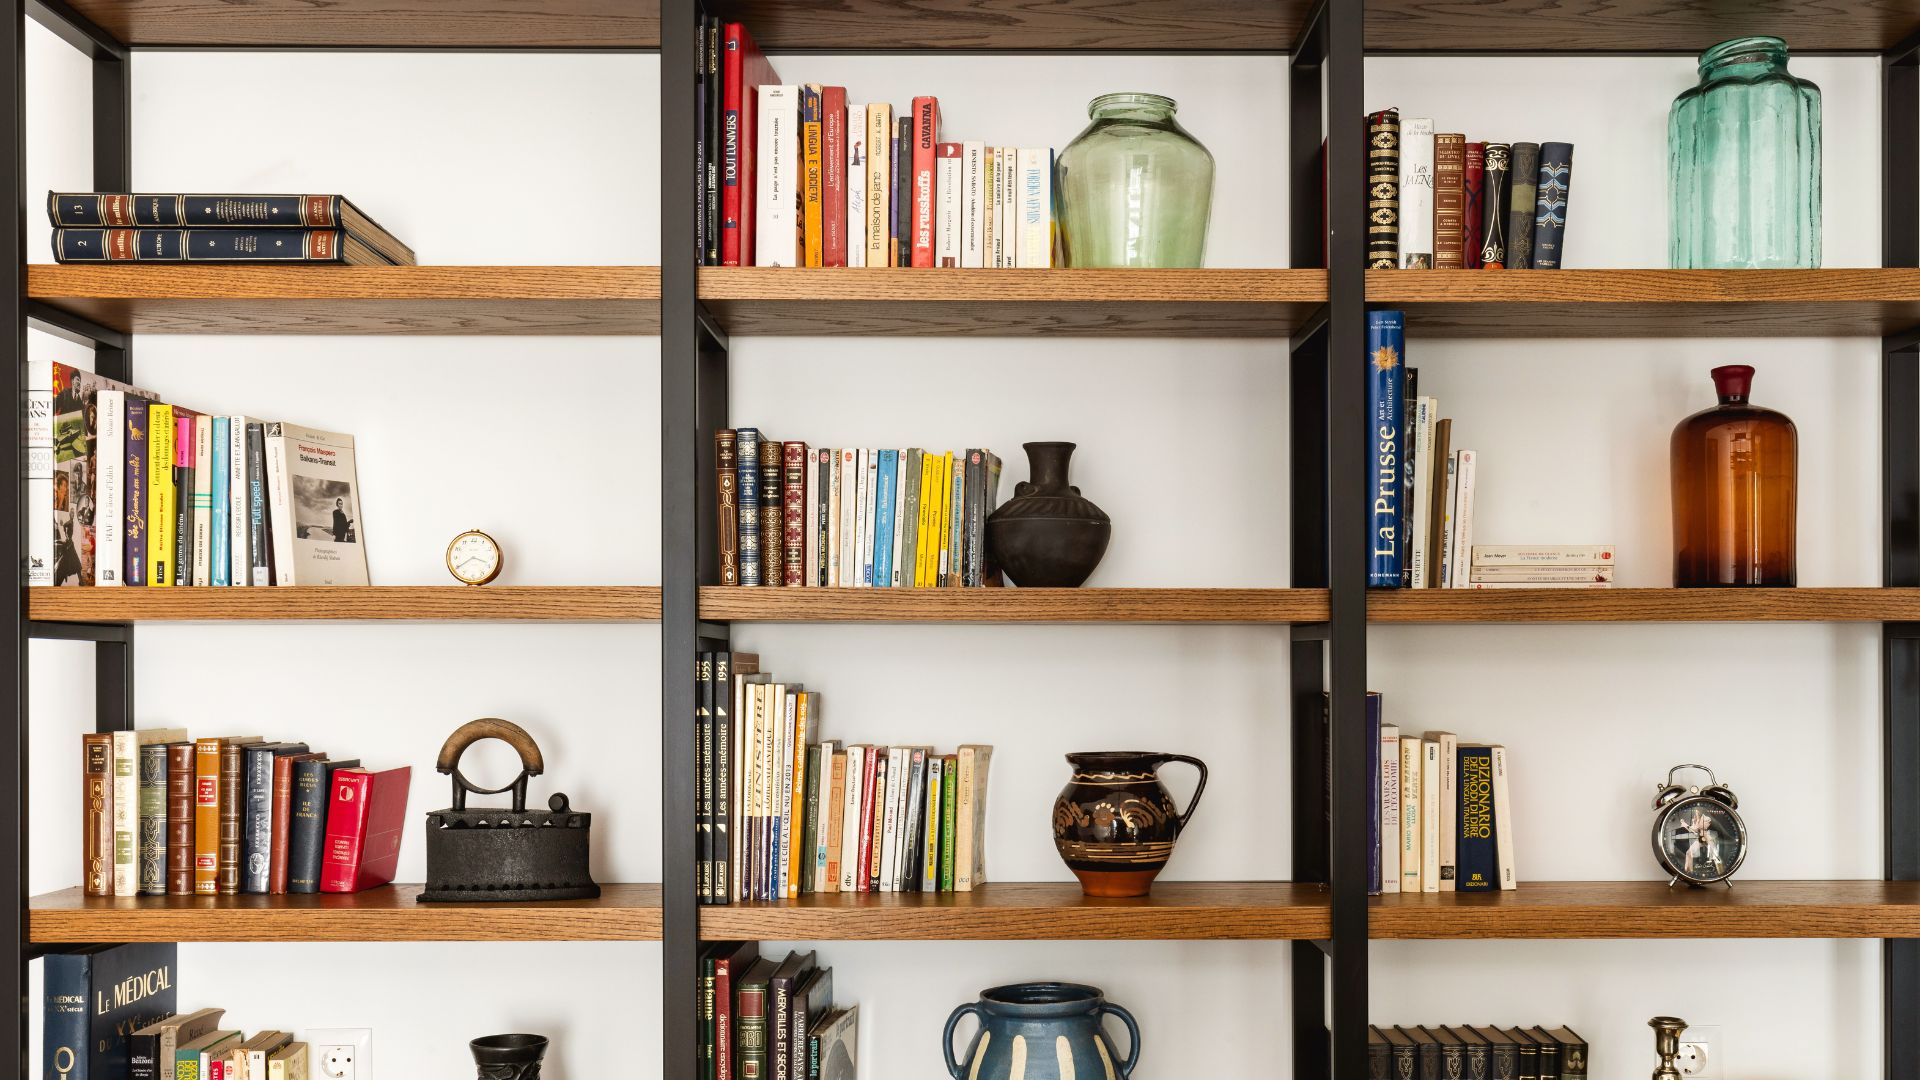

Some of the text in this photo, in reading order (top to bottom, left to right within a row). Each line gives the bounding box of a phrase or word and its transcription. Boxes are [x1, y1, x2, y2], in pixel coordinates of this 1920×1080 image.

[828, 113, 836, 143] d'Europe
[921, 102, 932, 149] CAVANNA
[725, 114, 737, 181] TOUT L'UNIVERS
[808, 124, 819, 156] LINGUA
[1414, 163, 1428, 173] Les
[112, 195, 122, 218] million
[870, 193, 880, 205] de
[1026, 168, 1041, 224] FOREIGN AFFAIRS
[74, 205, 84, 216] 13
[916, 170, 932, 249] les russkoffs
[870, 206, 881, 242] maison
[118, 230, 127, 252] million
[1378, 400, 1385, 409] et
[1386, 377, 1394, 421] Architecture
[153, 410, 161, 429] obtenir
[153, 435, 161, 460] demander
[298, 444, 336, 457] François Maspero
[152, 460, 161, 486] Comment
[299, 454, 337, 468] Balkans-Transit
[250, 480, 263, 507] speed
[1373, 425, 1397, 560] La Prusse
[105, 508, 113, 519] Le
[252, 508, 263, 526] Full
[105, 524, 113, 543] PIAF
[178, 535, 184, 544] du
[701, 660, 711, 887] Larousse Les années-mémoire 1955
[717, 660, 727, 887] Larousse Les années-mémoire 1954
[783, 795, 790, 807] NU
[784, 783, 791, 794] EN
[1404, 785, 1411, 799] LA
[1469, 756, 1479, 839] DEI MODI DI DIRE
[1479, 755, 1491, 839] DIZIONARIO
[1390, 812, 1398, 825] DE
[781, 857, 788, 866] LE
[844, 874, 852, 887] dtv
[98, 965, 172, 1015] LE MÉDICAL
[704, 976, 716, 987] la
[704, 988, 716, 1021] faune
[777, 987, 787, 1040] MERVEILLES
[719, 1013, 728, 1052] dictionnaire
[797, 1011, 805, 1072] L'ARRIÈRE-PAYS
[777, 1041, 787, 1051] ET
[809, 1039, 819, 1077] le portrait
